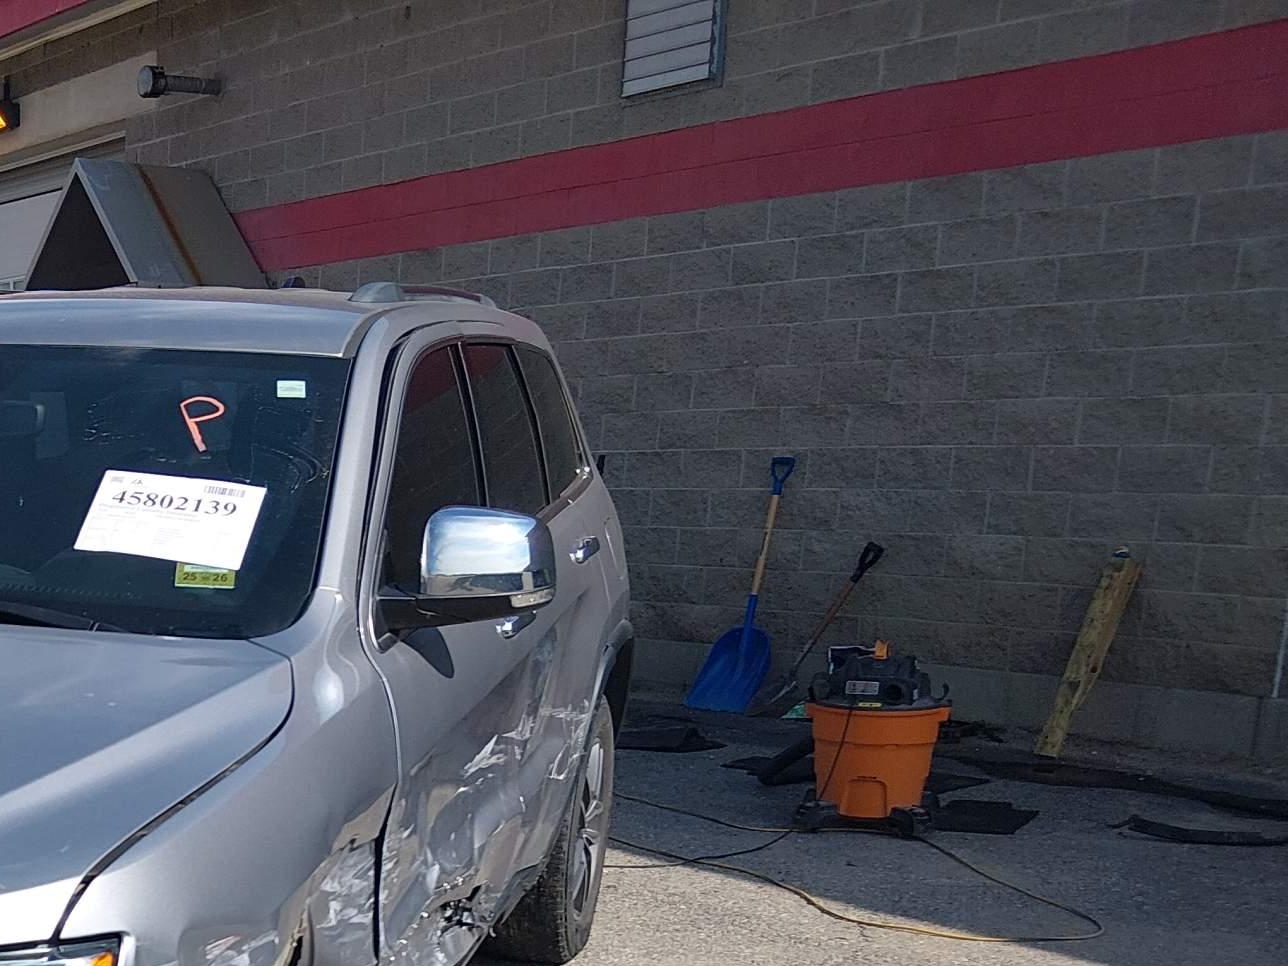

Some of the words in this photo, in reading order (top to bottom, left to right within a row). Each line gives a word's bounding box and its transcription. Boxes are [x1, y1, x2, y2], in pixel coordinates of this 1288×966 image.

[179, 395, 226, 453] P
[111, 490, 238, 517] 45802139
[183, 572, 198, 581] 25
[213, 573, 229, 582] 26
